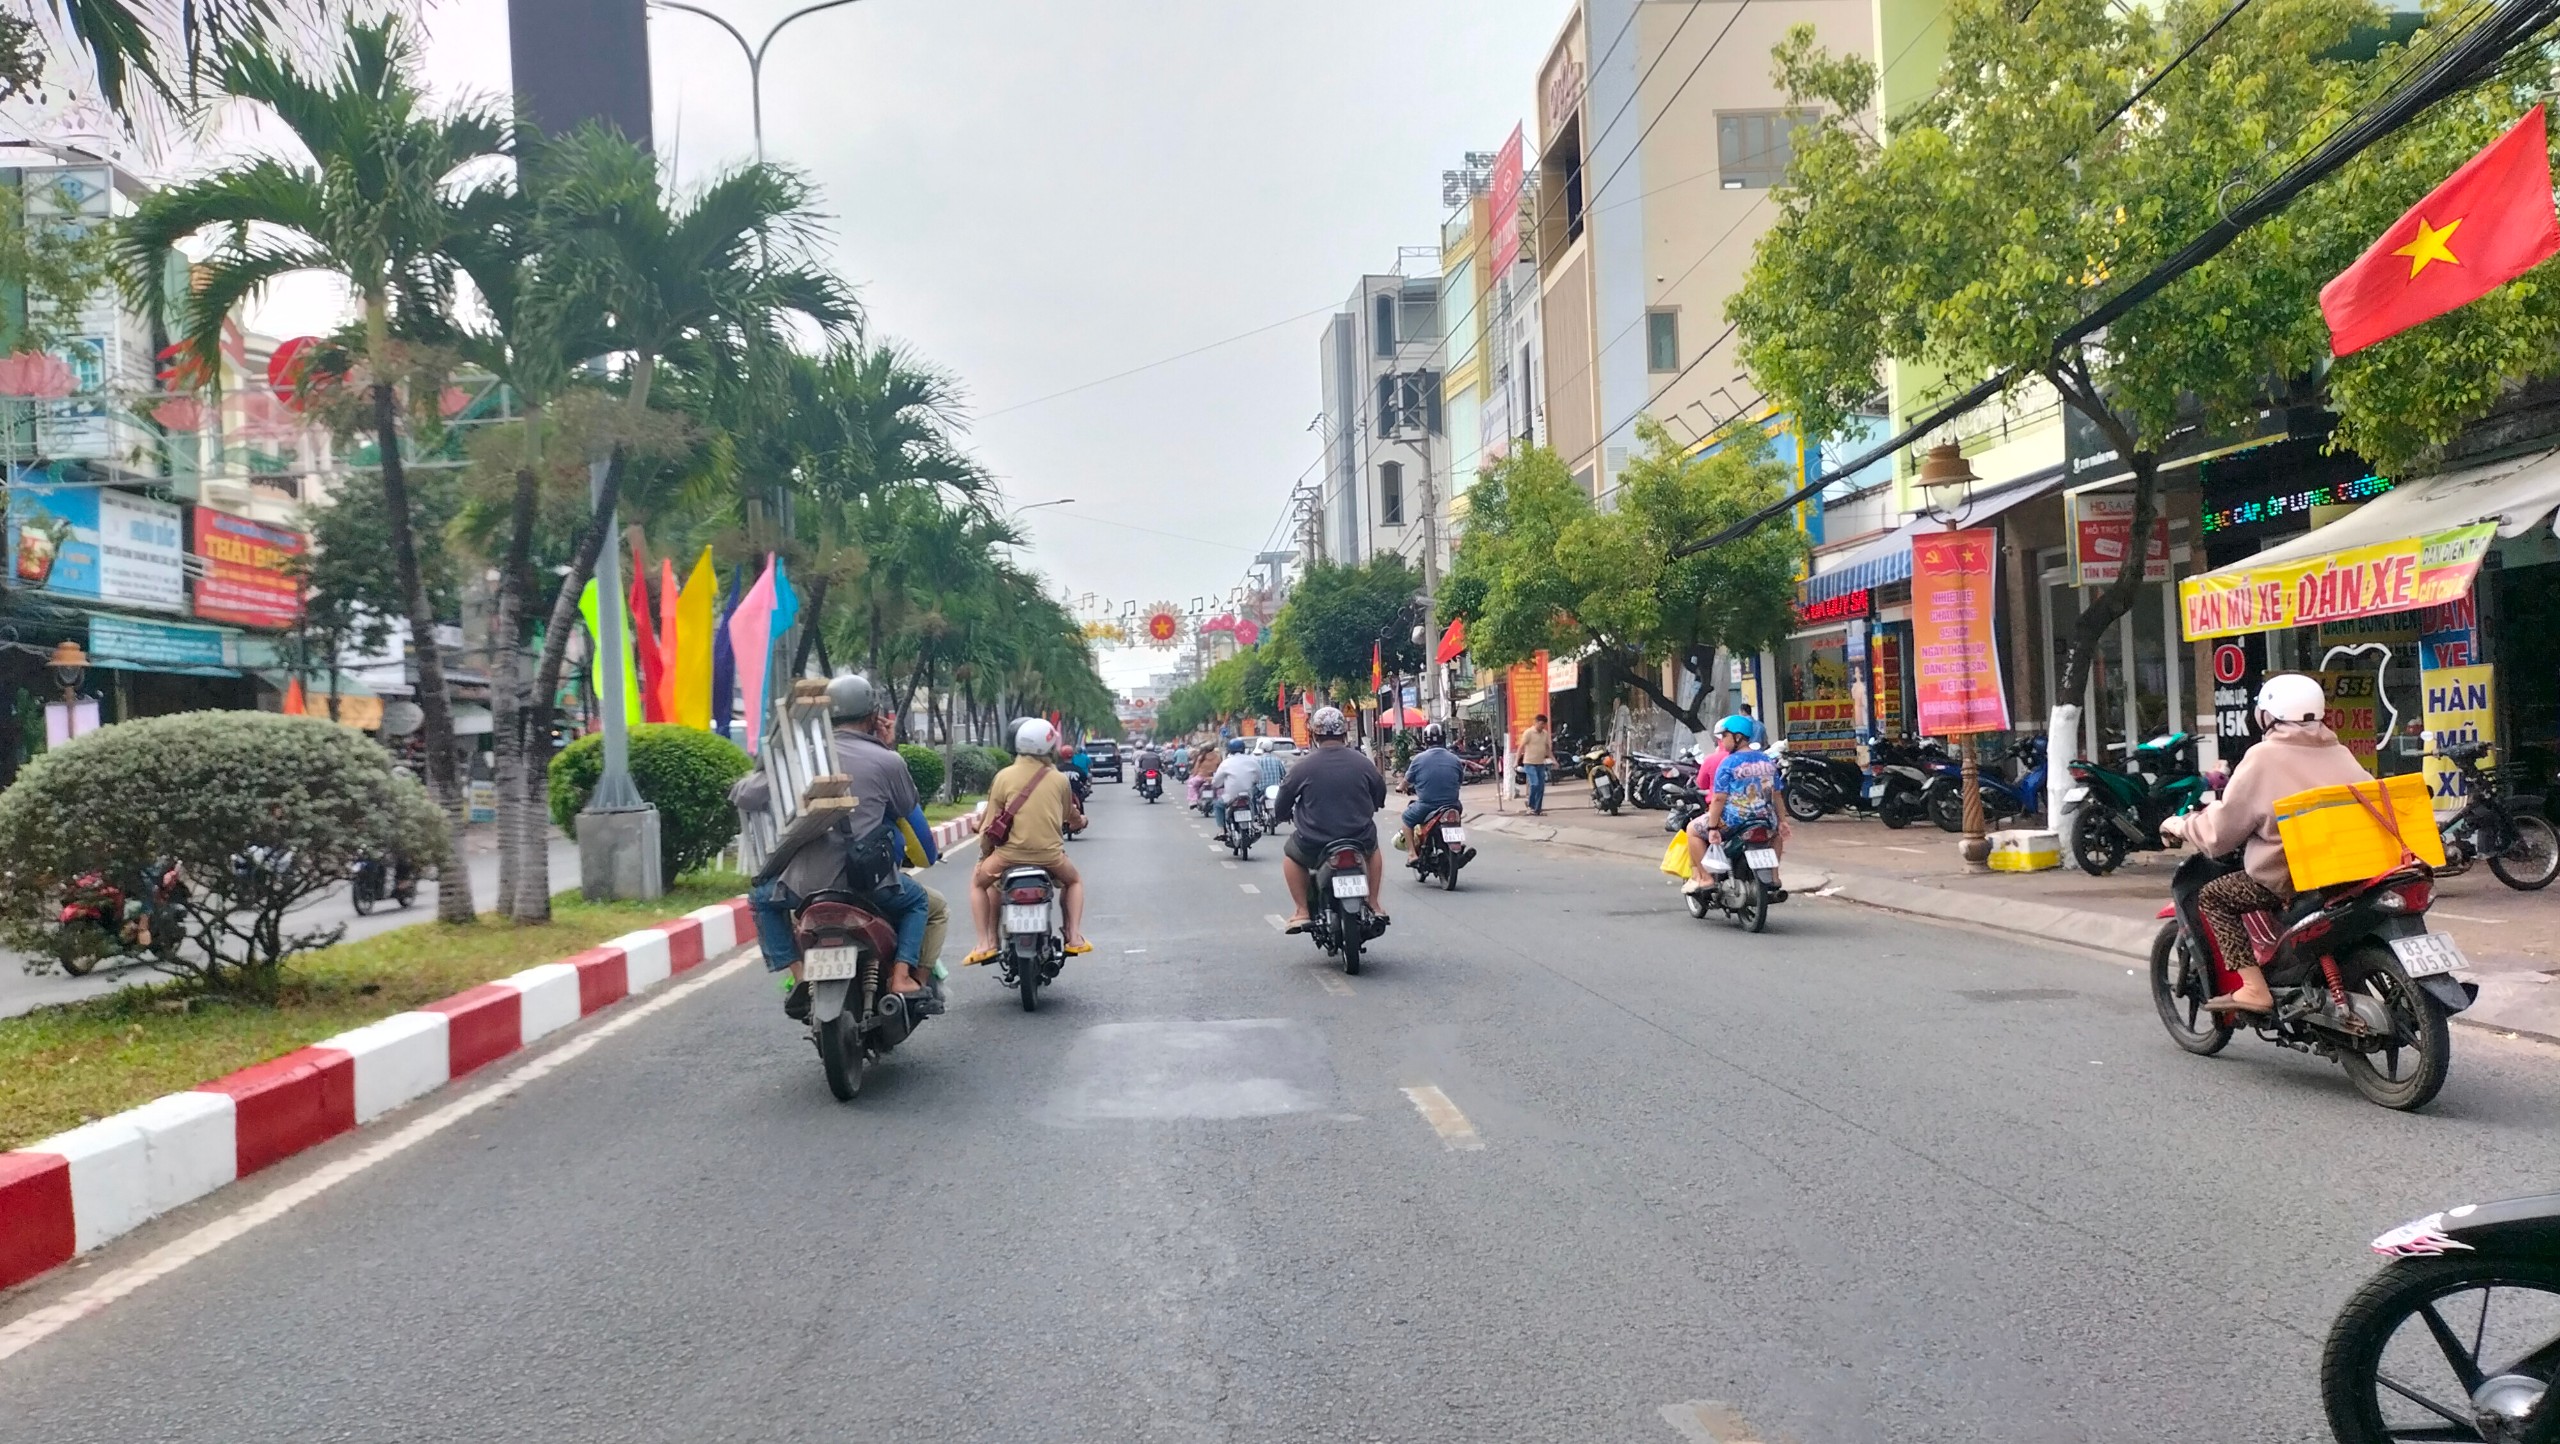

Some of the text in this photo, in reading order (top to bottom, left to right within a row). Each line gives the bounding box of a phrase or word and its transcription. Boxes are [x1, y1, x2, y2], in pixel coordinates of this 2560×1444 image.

[2258, 581, 2283, 624] XE
[2297, 562, 2363, 621] DÁN
[2366, 555, 2416, 610] XE
[2428, 679, 2487, 713] HÀN
[2216, 710, 2250, 737] 15K
[2324, 708, 2373, 730] EO XE
[2402, 936, 2447, 956] 83-C1
[2406, 951, 2464, 974] 205.81
